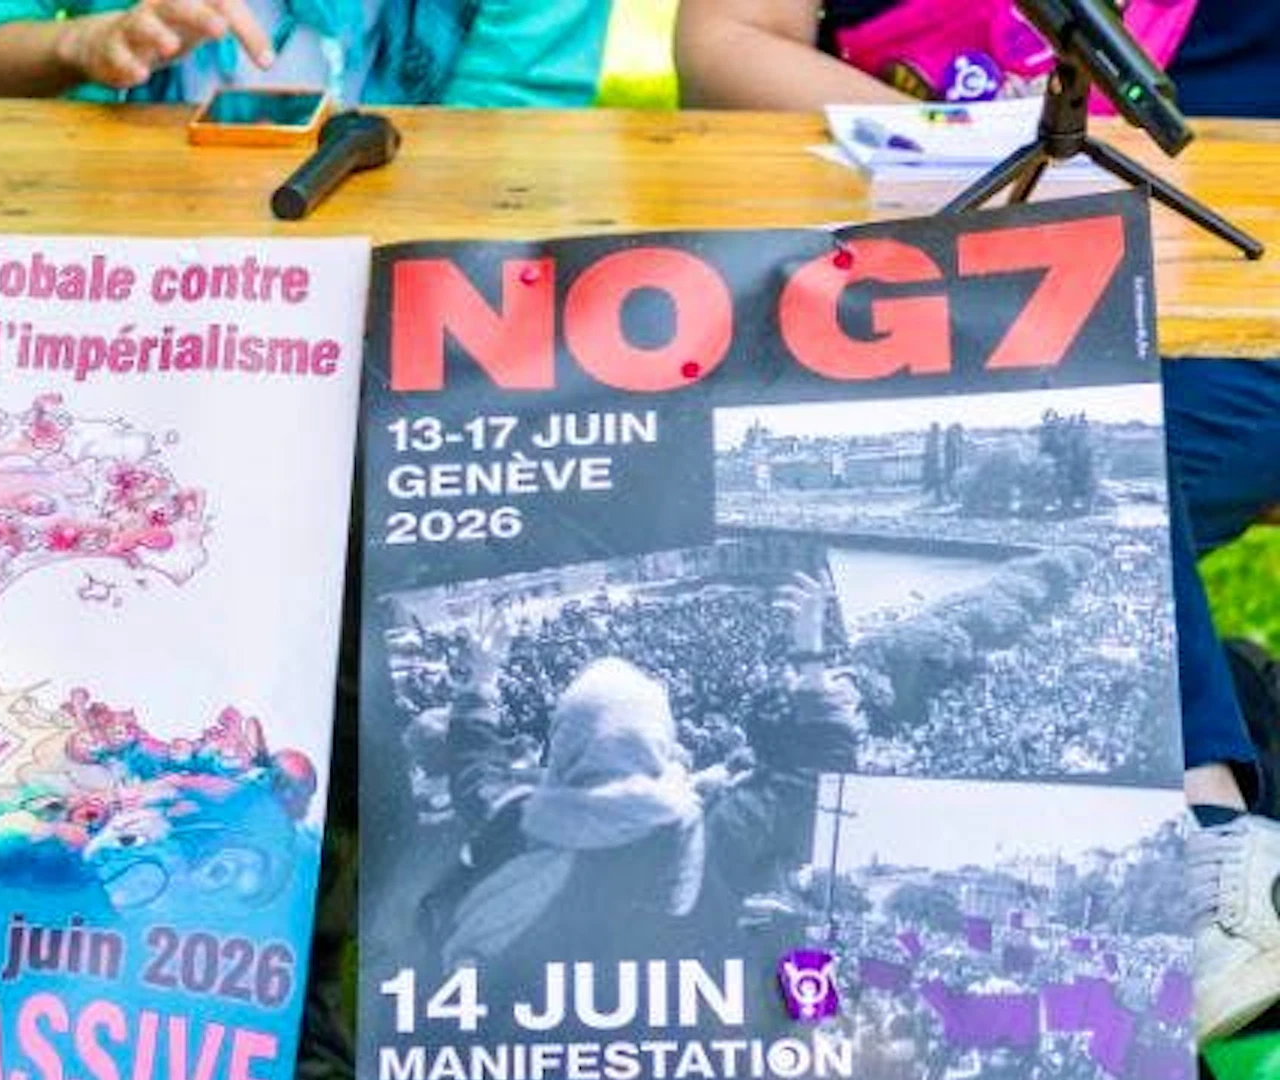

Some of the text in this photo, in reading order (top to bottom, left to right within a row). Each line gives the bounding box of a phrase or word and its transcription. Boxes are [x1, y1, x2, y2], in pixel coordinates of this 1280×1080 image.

[151, 256, 311, 304] contre
[389, 246, 734, 393] NO
[778, 213, 1128, 382] G7
[387, 409, 659, 452] 13-17 JUIN
[385, 452, 613, 500] GENÈVE
[384, 505, 523, 545] 2026
[1, 913, 123, 981] juin
[142, 926, 295, 1010] 2026
[379, 958, 746, 1034] 14 JUIN
